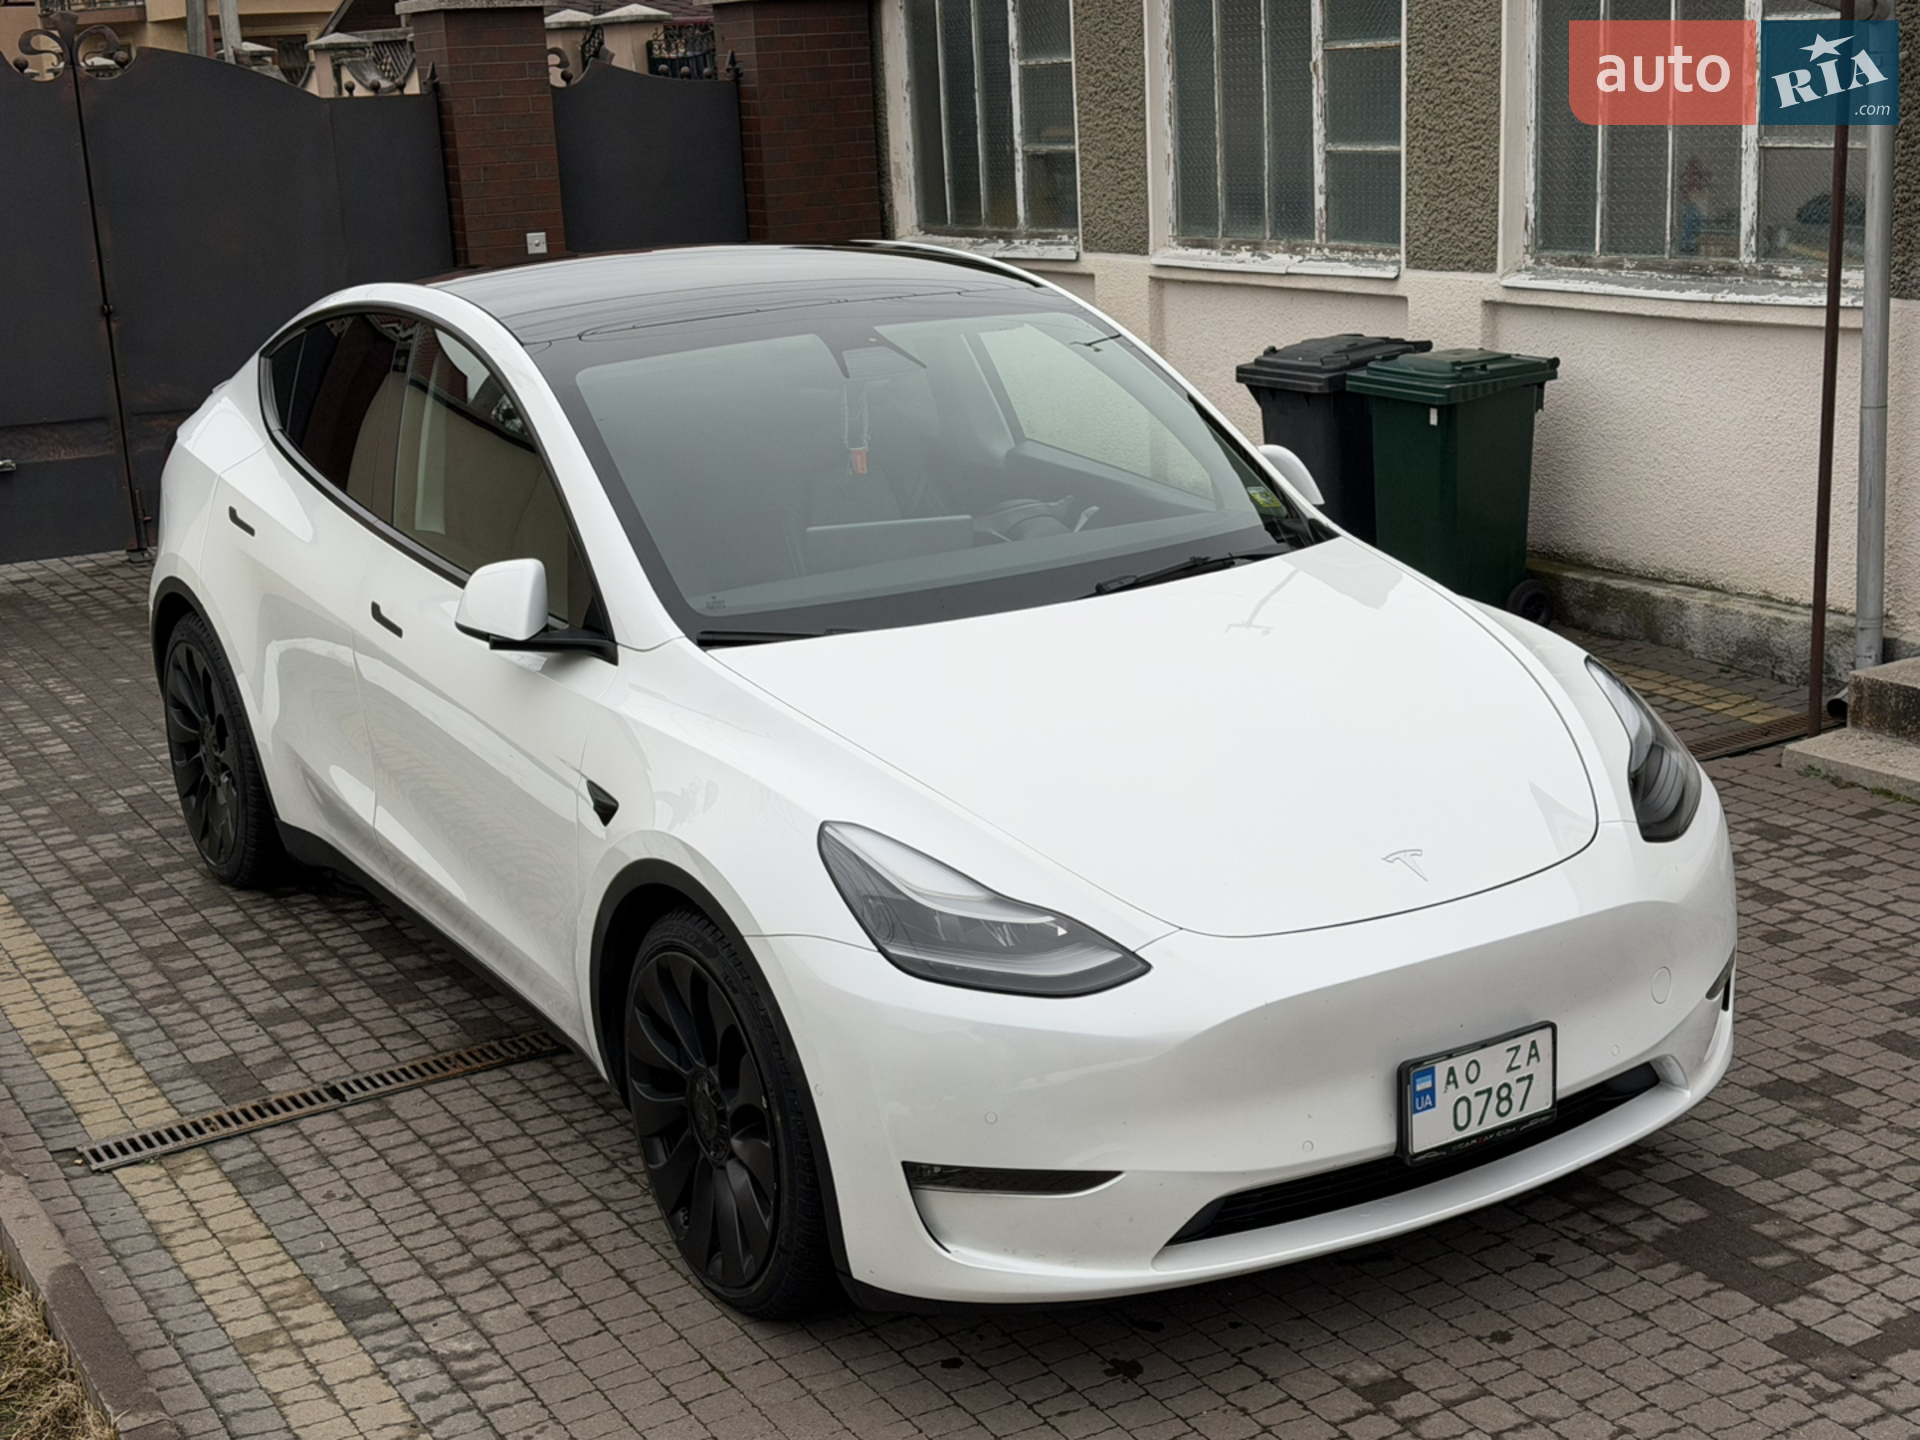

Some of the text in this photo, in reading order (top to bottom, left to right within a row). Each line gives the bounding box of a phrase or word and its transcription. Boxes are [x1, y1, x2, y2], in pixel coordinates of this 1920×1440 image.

[1443, 1039, 1541, 1094] AO ZA
[1415, 1094, 1433, 1110] UA
[1452, 1073, 1534, 1132] 0787
